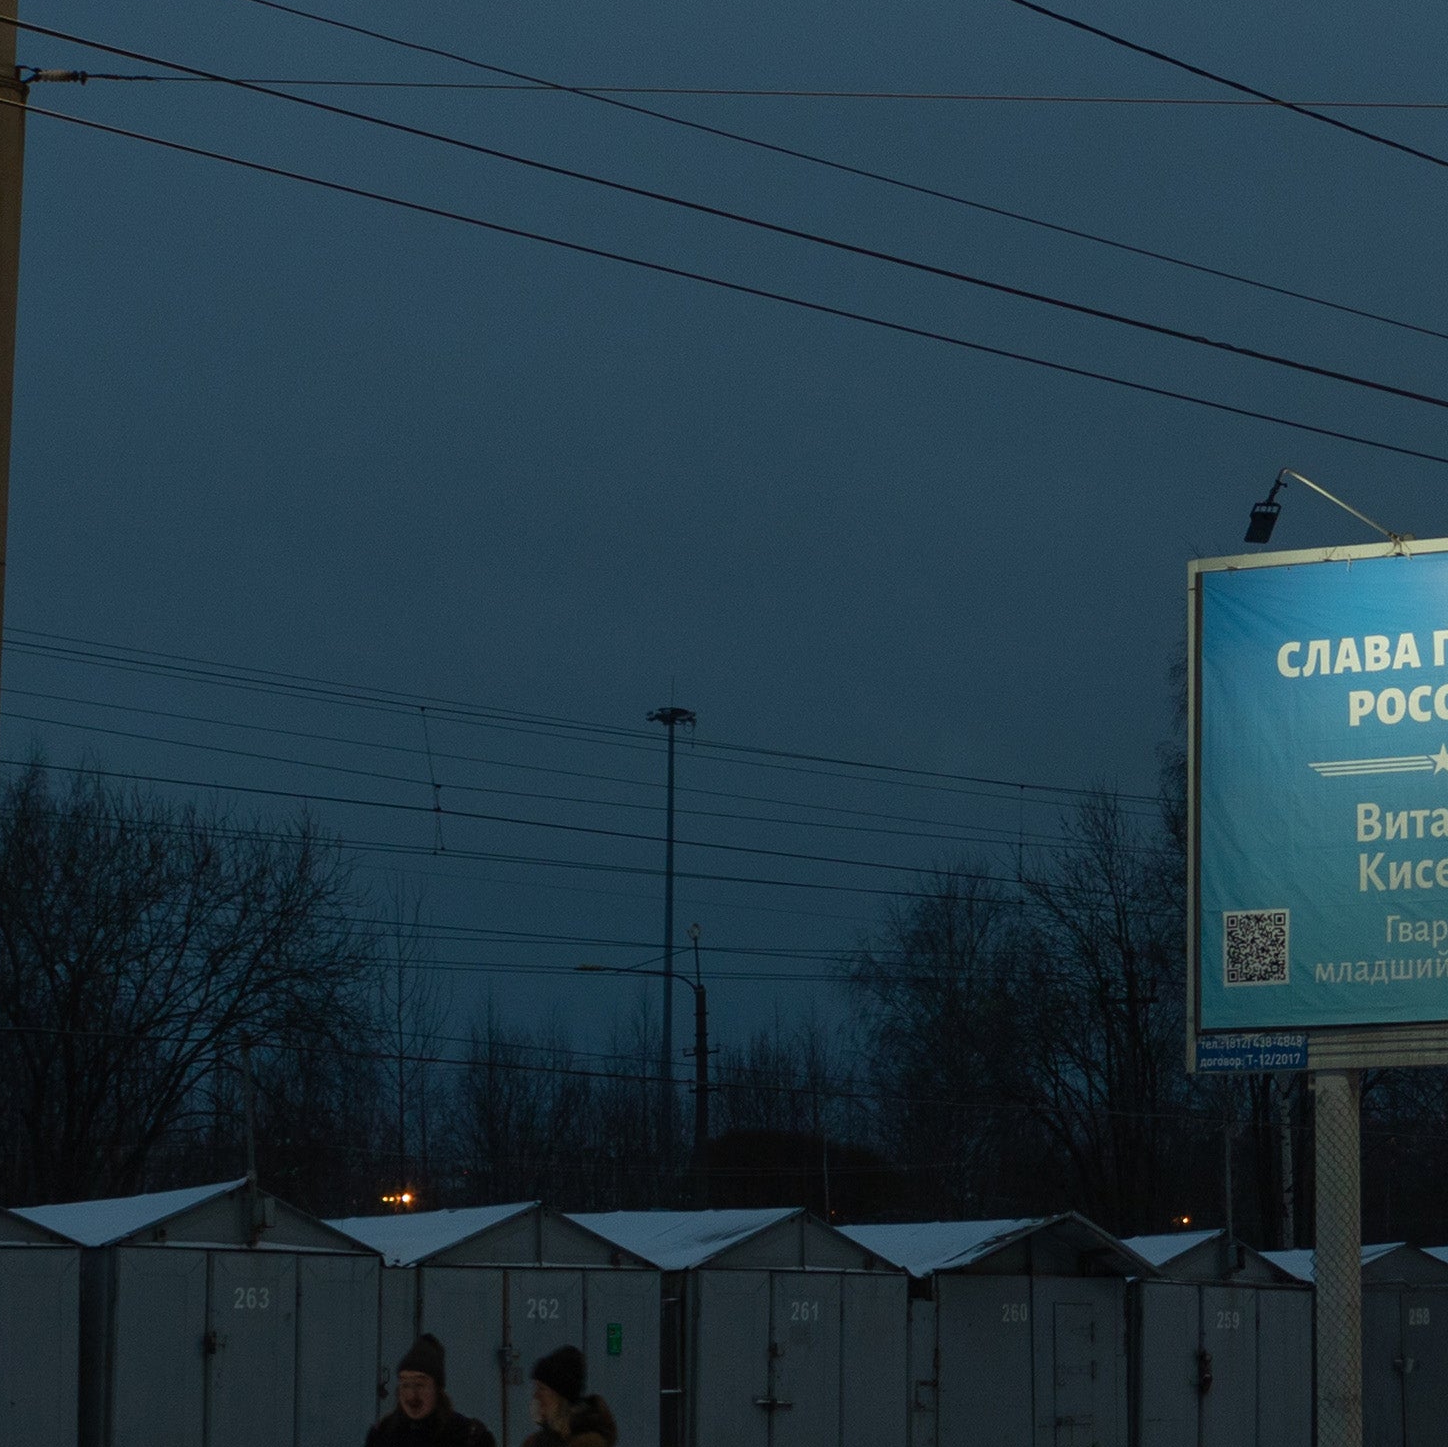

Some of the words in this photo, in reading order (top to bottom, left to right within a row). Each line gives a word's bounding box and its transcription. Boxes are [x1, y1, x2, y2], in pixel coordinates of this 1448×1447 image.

[1277, 632, 1421, 679] СЛАВА
[233, 1286, 270, 1309] 263
[526, 1297, 559, 1319] 262
[791, 1301, 819, 1322] 261
[1001, 1303, 1028, 1322] 260
[1216, 1311, 1240, 1329] 259
